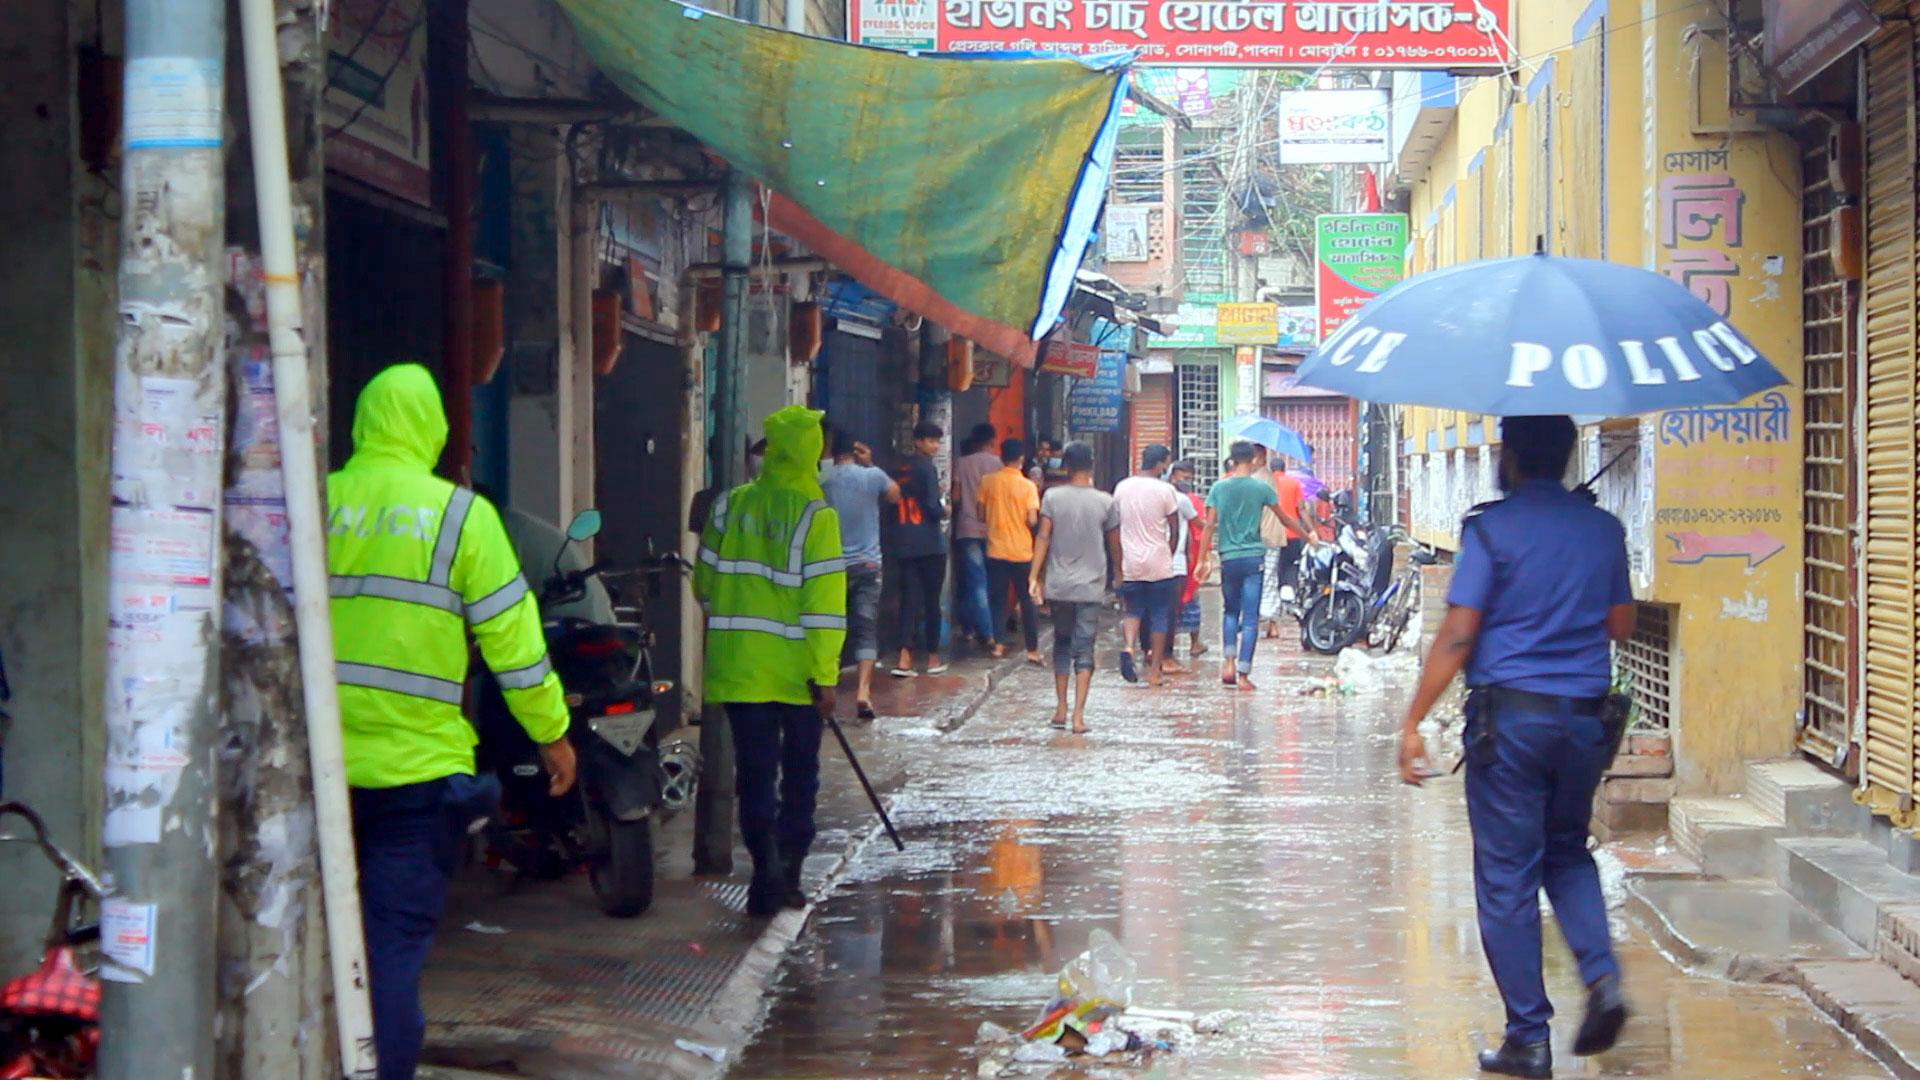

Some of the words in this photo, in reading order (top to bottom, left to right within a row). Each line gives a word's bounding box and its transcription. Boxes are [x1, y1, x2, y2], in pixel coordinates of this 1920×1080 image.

[1159, 1, 1287, 32] হোটেল
[1664, 136, 1734, 172] মেসার্স
[1504, 321, 1758, 391] POLICE
[1659, 392, 1792, 447] হোসিয়ারী
